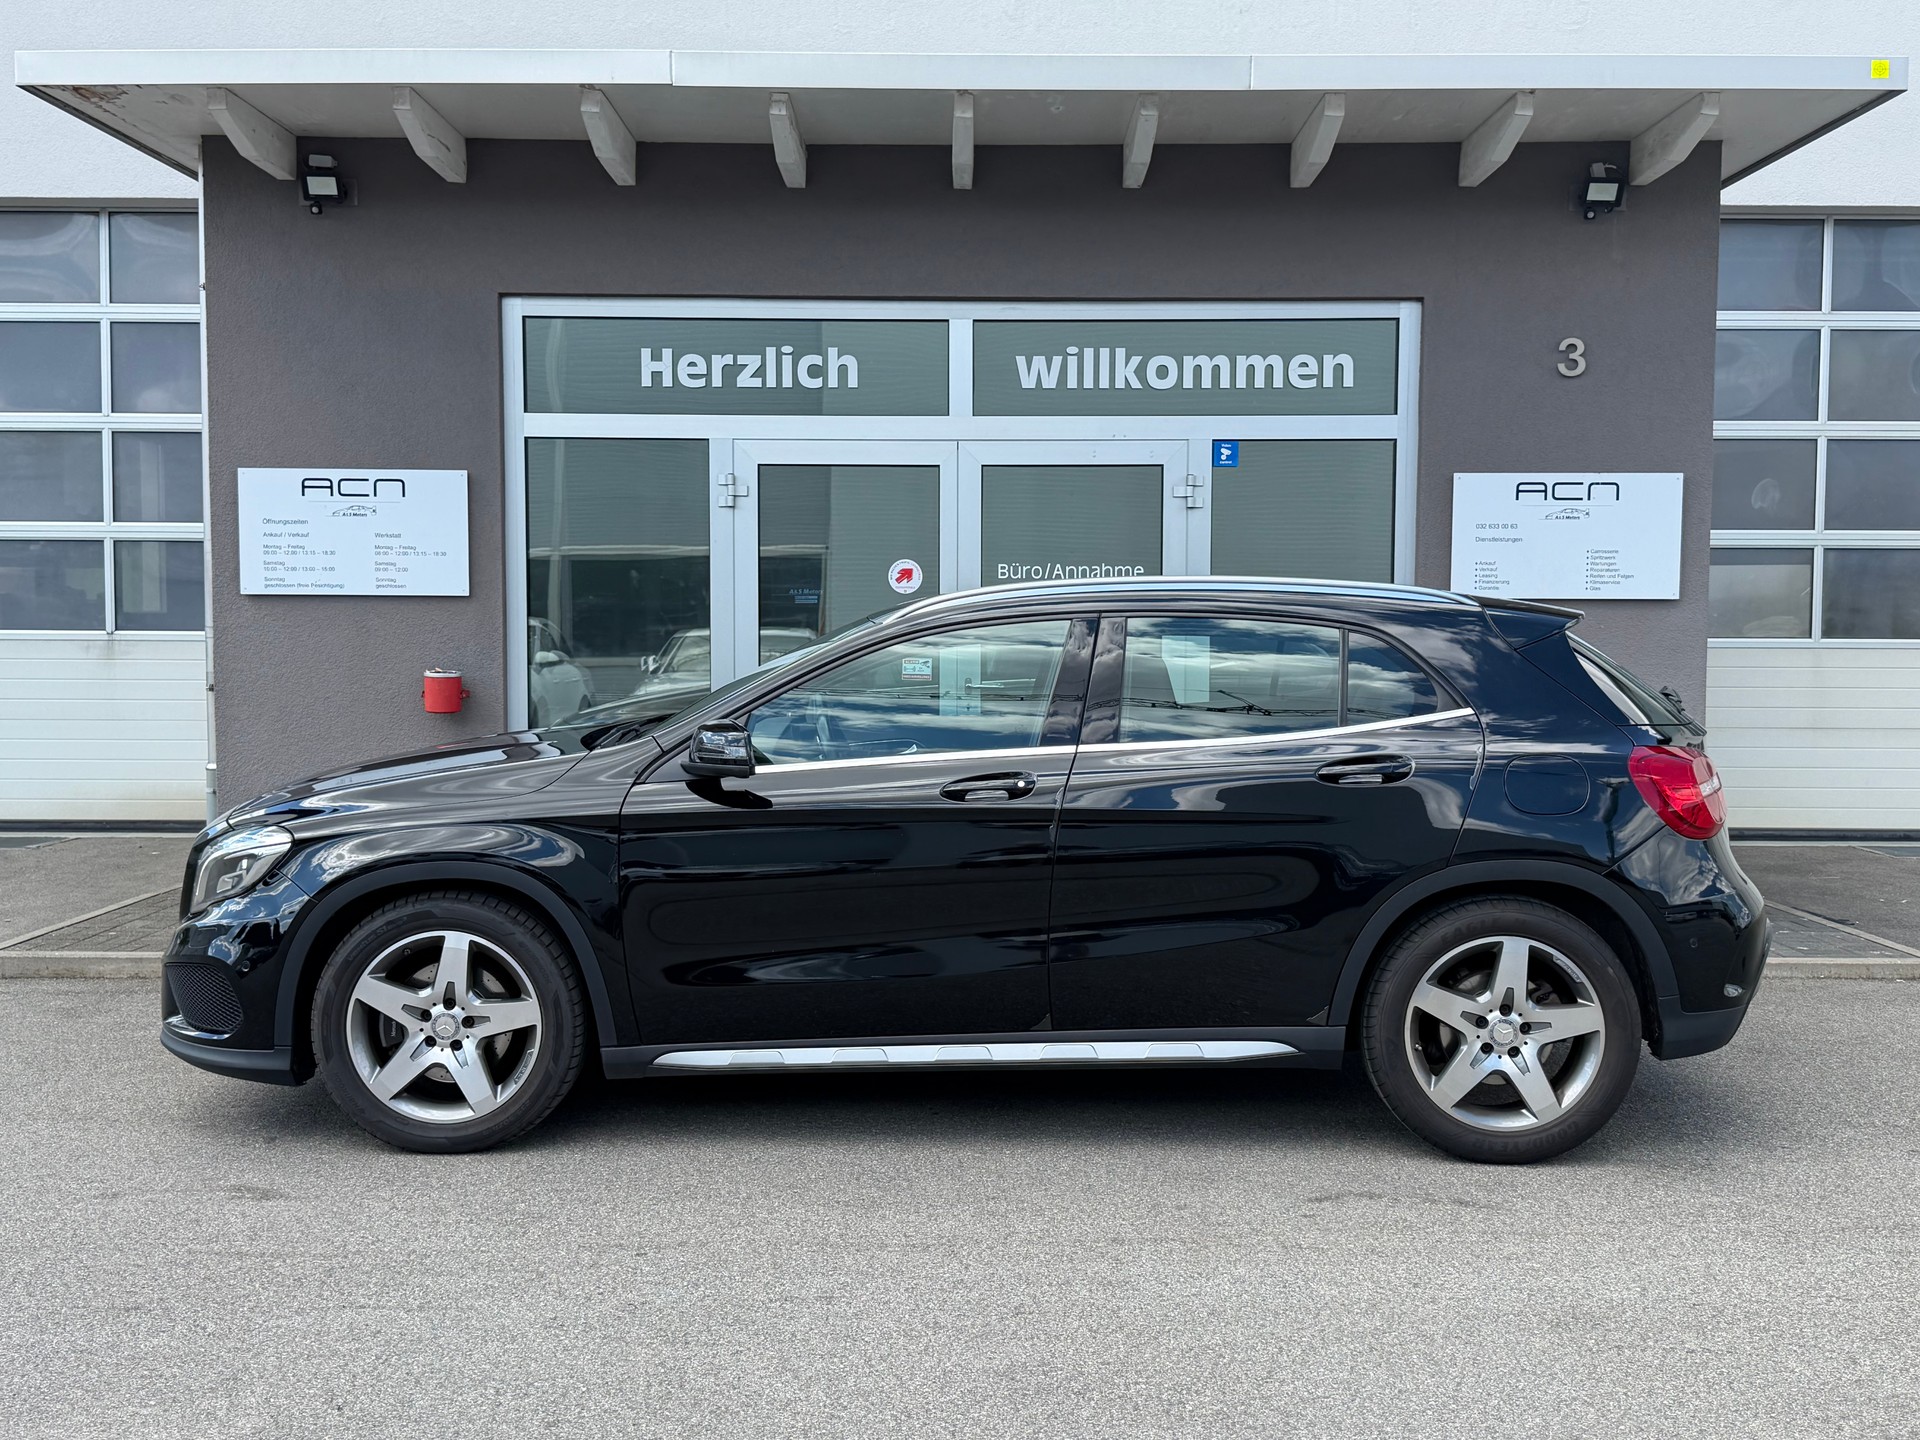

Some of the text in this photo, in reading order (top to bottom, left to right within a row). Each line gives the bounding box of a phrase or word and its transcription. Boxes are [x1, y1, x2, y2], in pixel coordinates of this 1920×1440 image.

[640, 346, 1354, 390] Herzlich willkommen
[1557, 338, 1586, 376] 3
[997, 563, 1144, 579] Büro/Annahme
